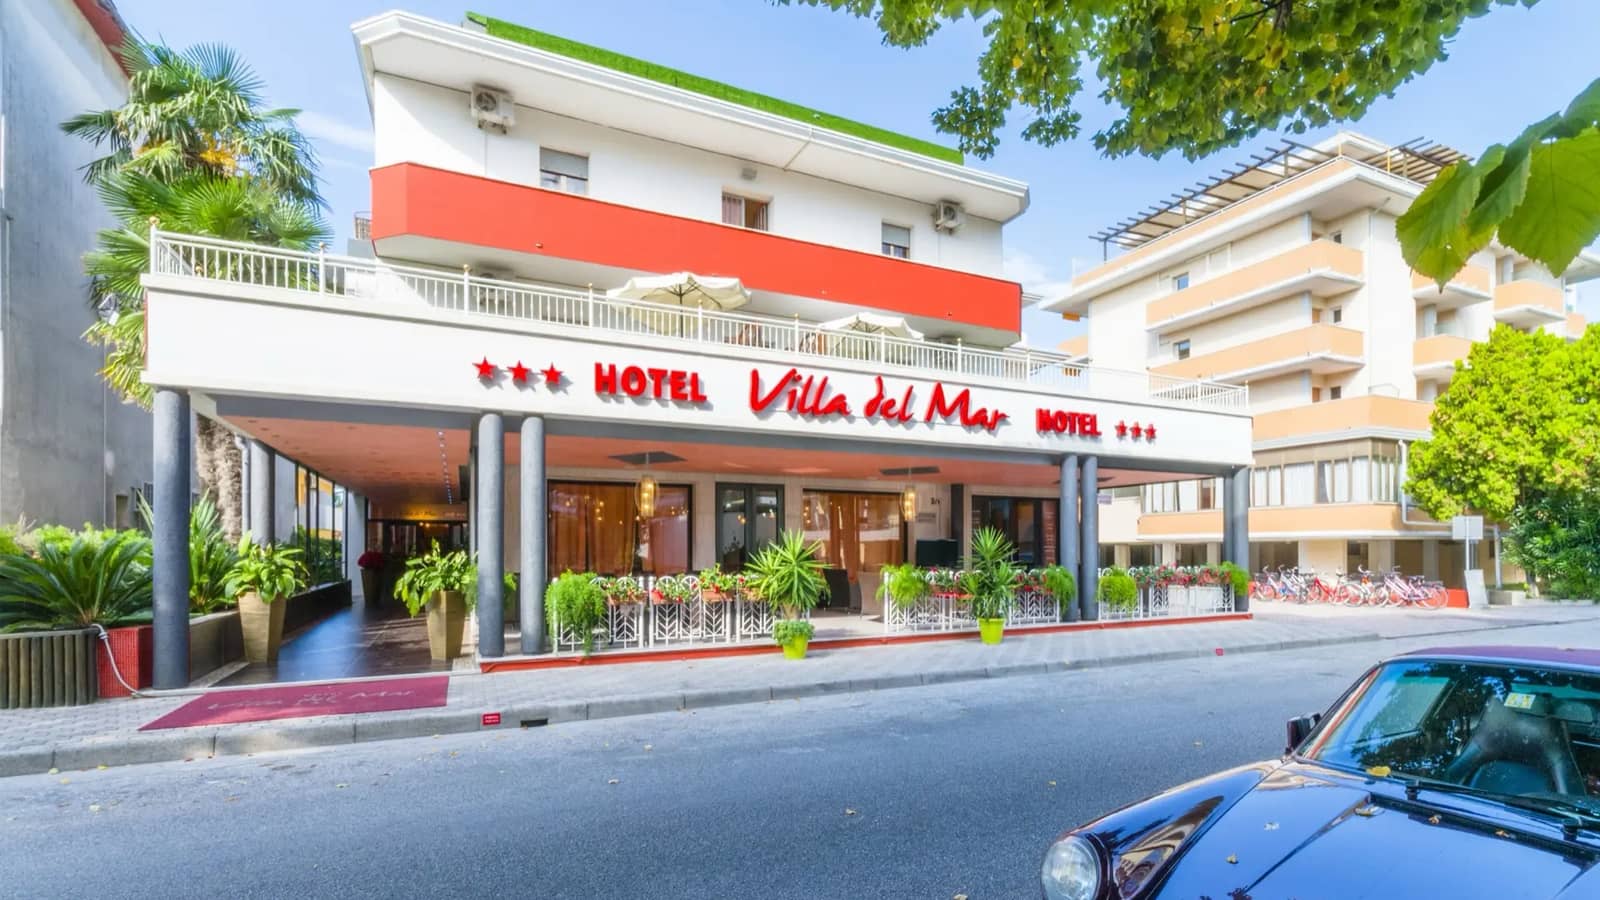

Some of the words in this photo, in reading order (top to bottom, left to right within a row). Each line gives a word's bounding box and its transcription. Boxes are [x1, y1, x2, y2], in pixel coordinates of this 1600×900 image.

[595, 362, 708, 402] HOTEL
[749, 368, 850, 417] Villa
[863, 375, 913, 422] del
[924, 381, 1009, 431] Mar
[1036, 408, 1101, 437] HOTEL
